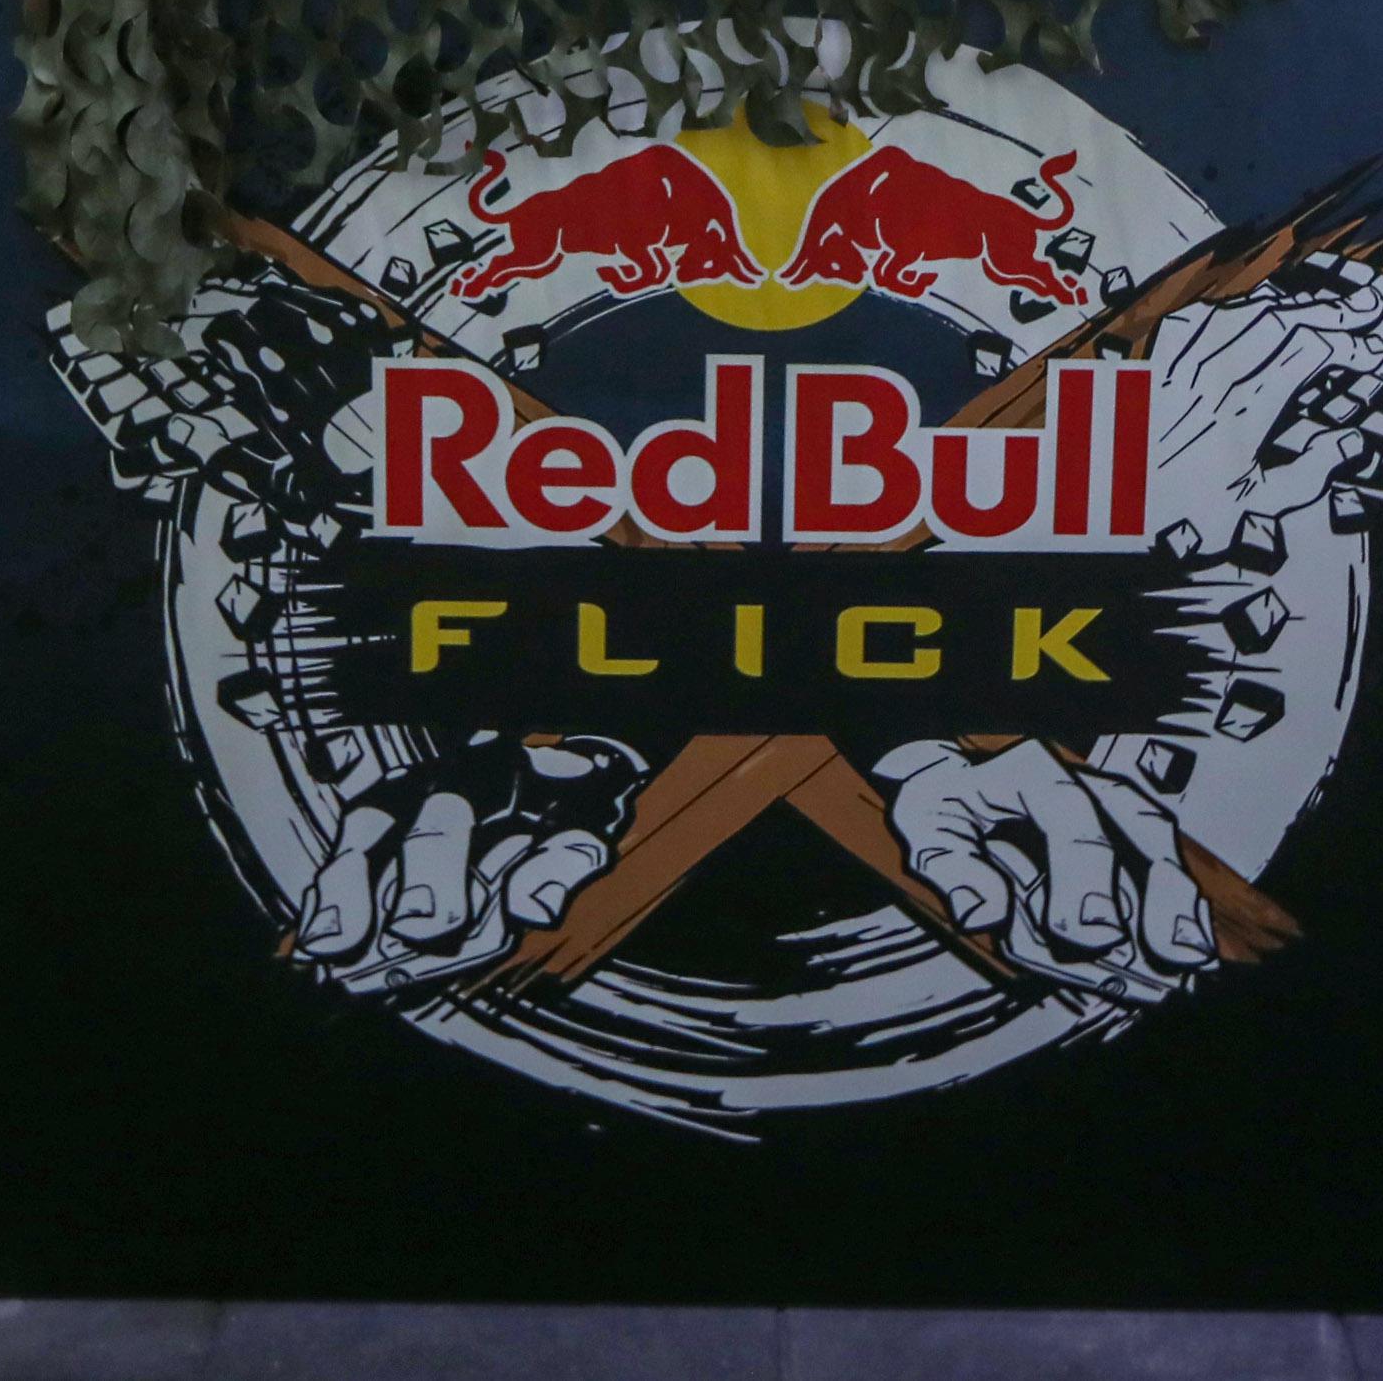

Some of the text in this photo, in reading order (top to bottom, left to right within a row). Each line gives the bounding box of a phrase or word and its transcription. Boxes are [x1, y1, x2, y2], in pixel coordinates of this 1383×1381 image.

[384, 364, 1152, 537] Red Bull
[410, 600, 1111, 682] FLICK
